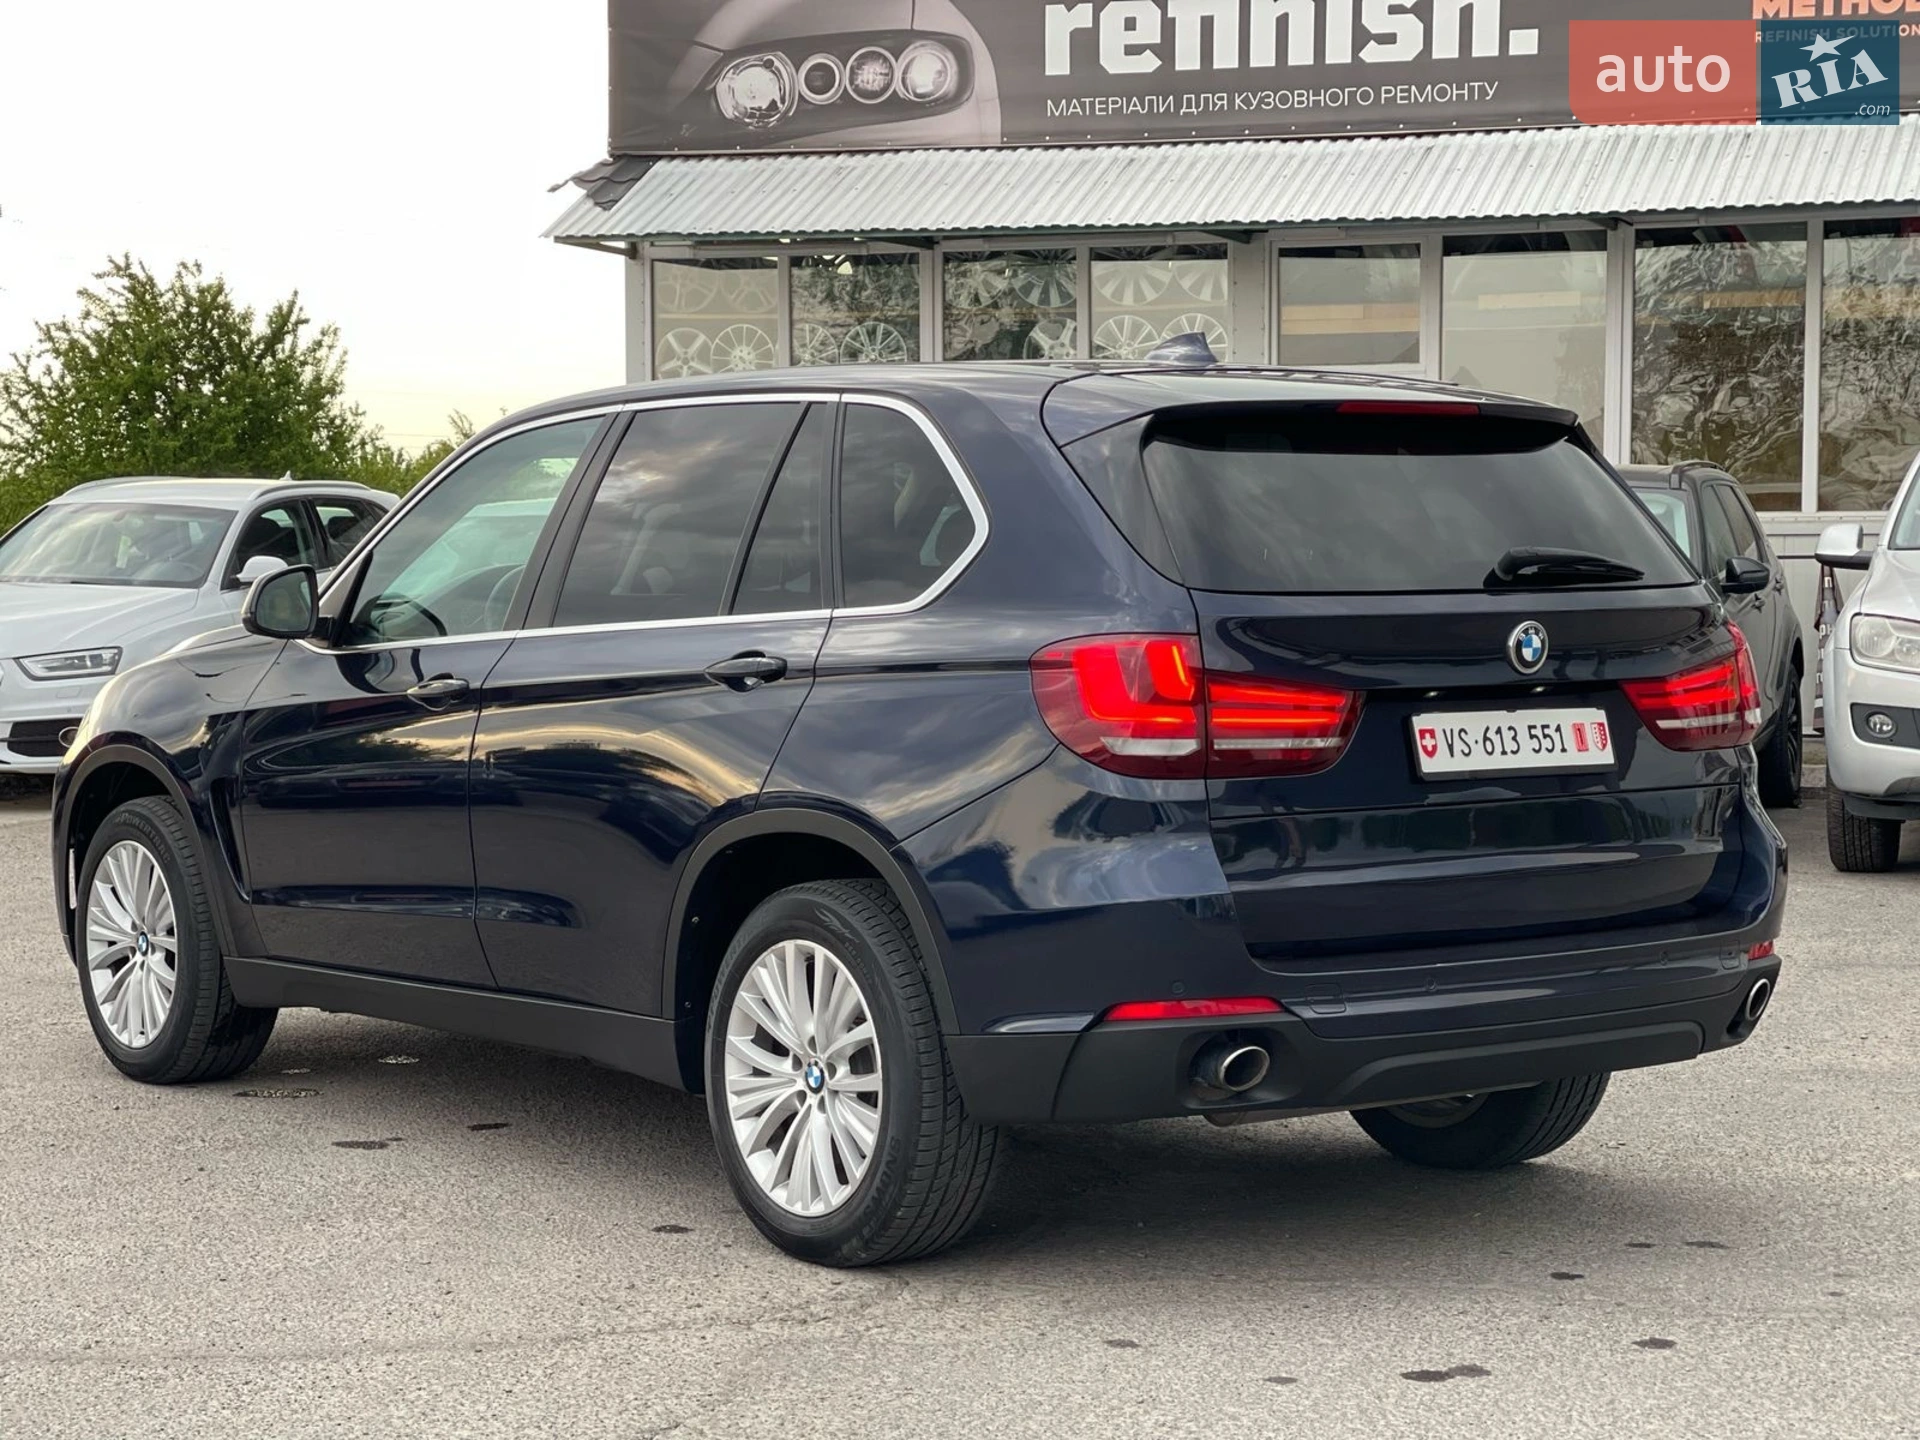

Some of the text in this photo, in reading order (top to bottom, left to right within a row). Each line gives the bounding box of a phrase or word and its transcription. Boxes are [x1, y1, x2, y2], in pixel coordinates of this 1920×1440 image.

[1047, 81, 1499, 117] МАТЕРІАЛИ ДЛЯ КУЗОВНОГО РЕМОНТУ
[1527, 723, 1567, 754] 551
